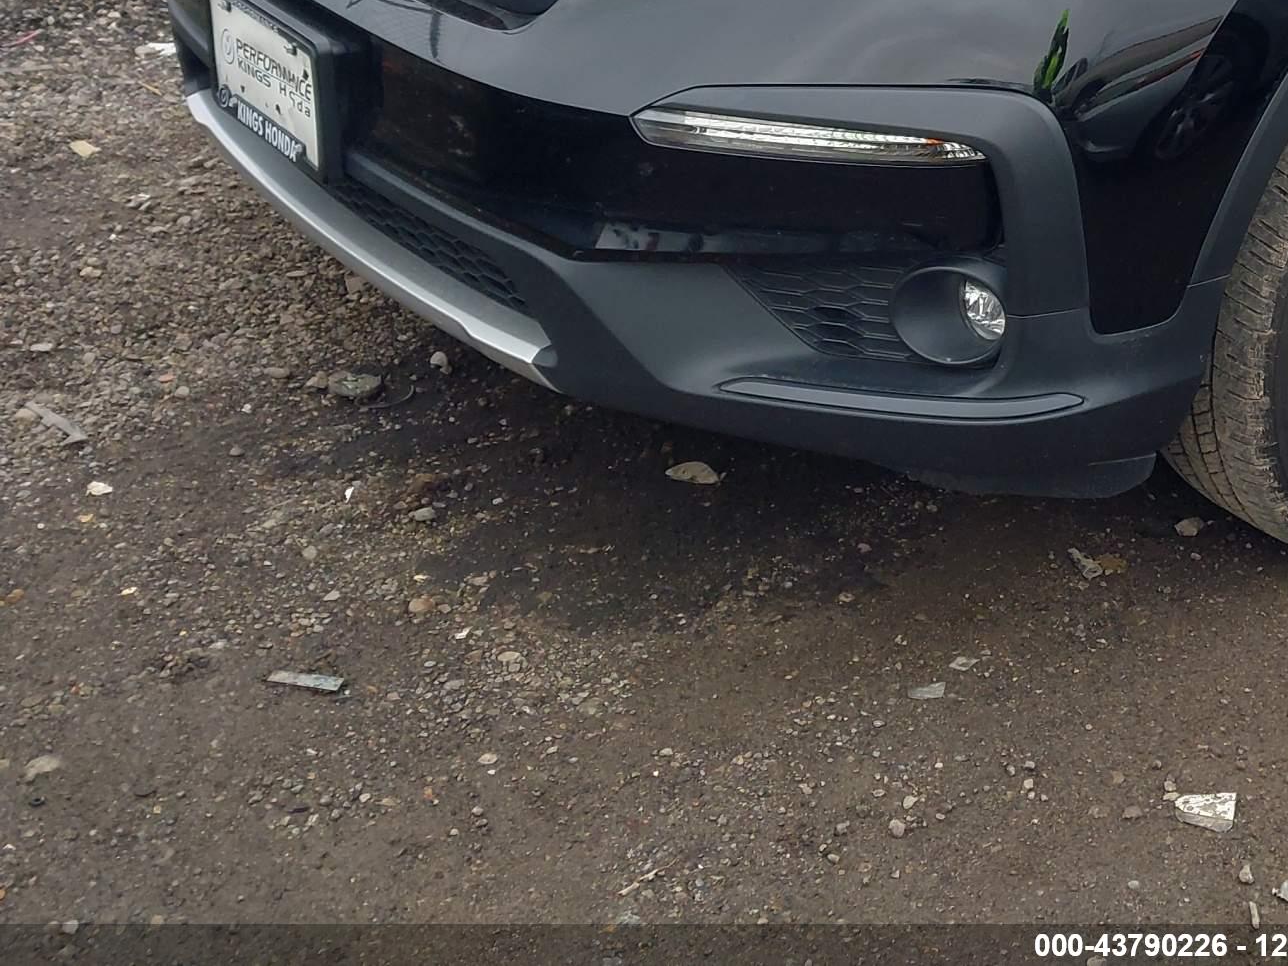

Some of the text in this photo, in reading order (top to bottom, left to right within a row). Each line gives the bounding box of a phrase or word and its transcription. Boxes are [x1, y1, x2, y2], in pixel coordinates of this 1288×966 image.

[236, 38, 312, 101] PERFORMANCE
[237, 57, 271, 88] KINGS
[237, 100, 298, 163] KINGS HONDA
